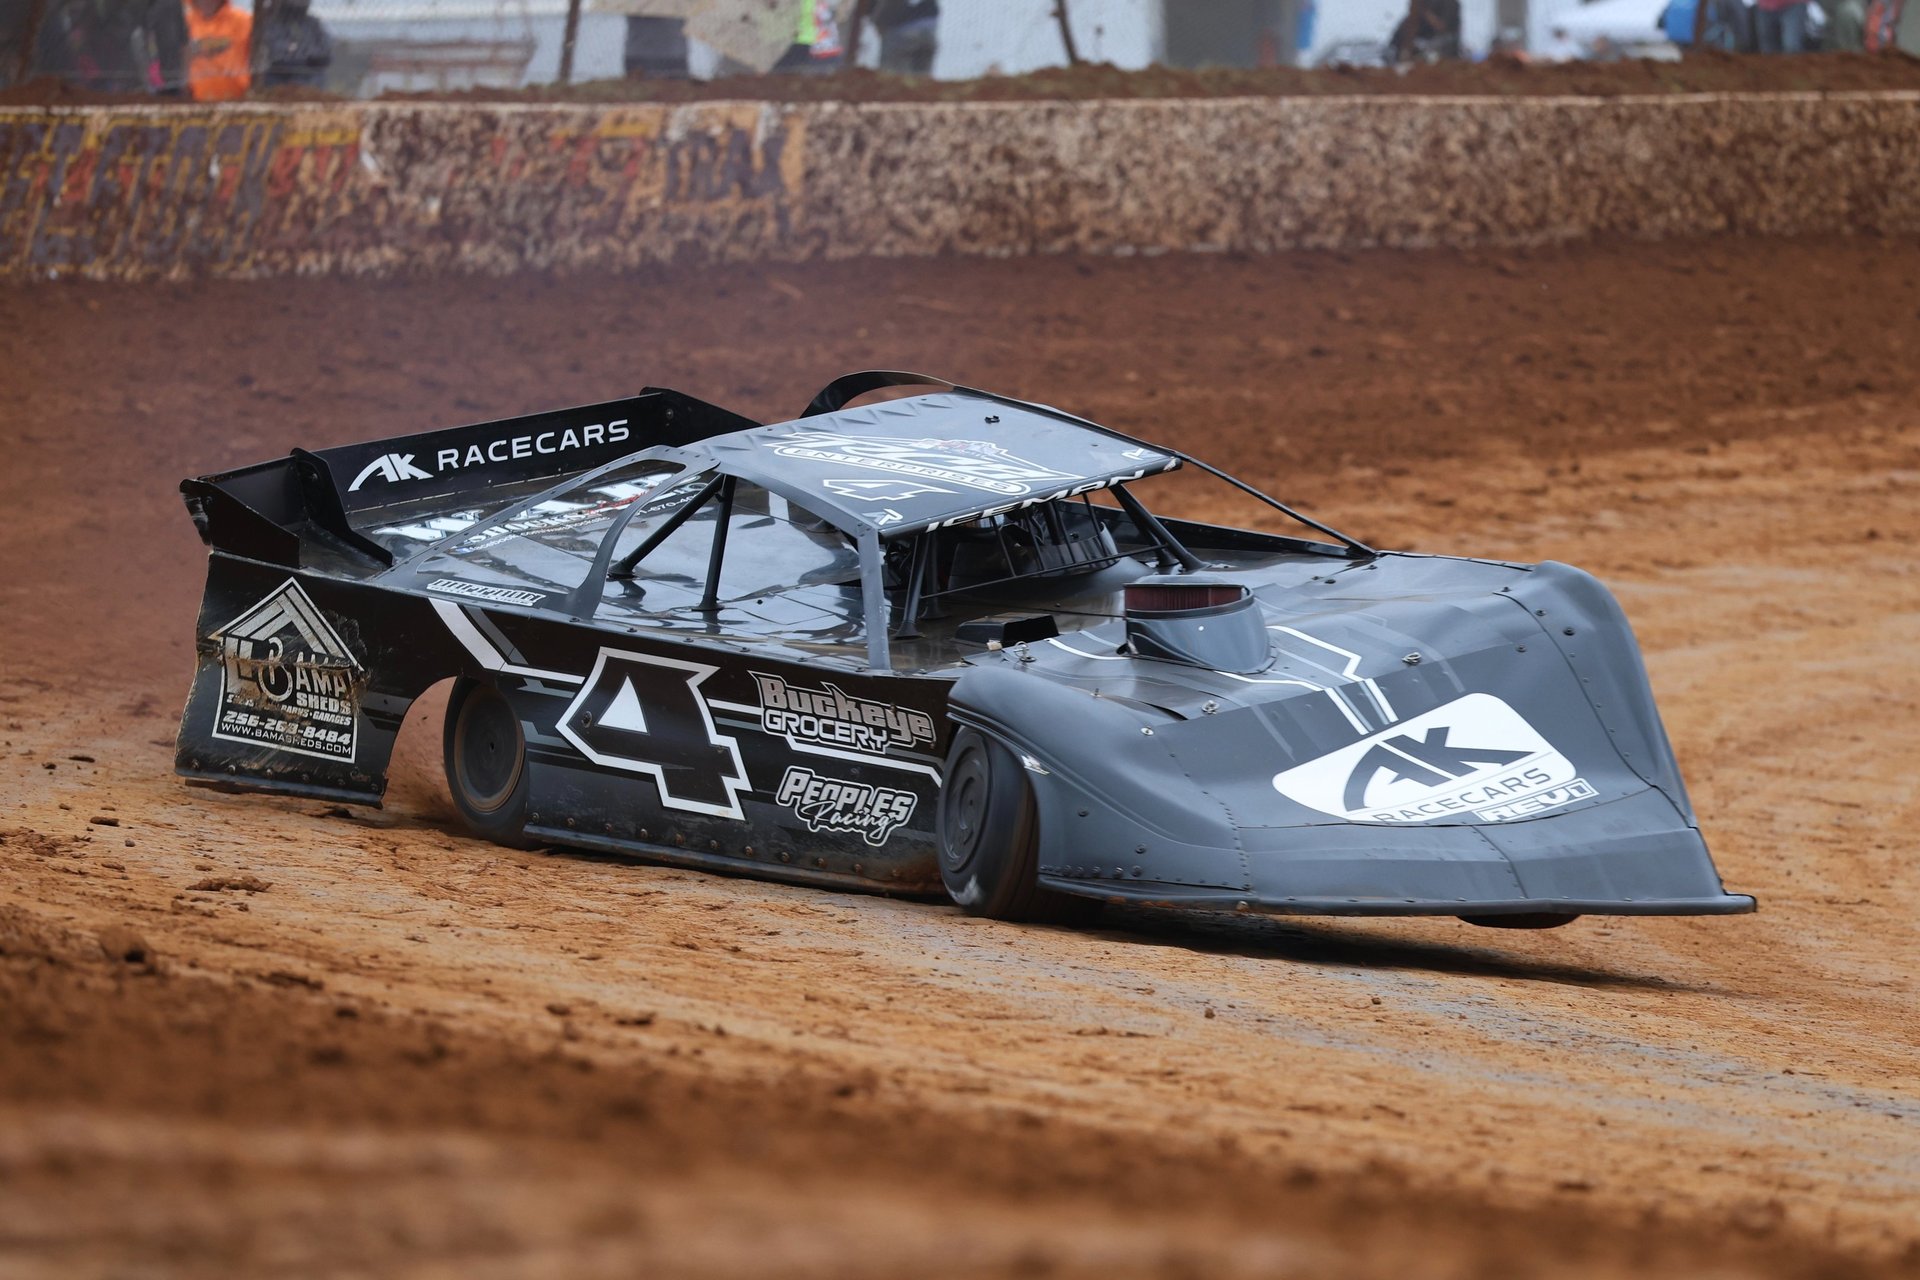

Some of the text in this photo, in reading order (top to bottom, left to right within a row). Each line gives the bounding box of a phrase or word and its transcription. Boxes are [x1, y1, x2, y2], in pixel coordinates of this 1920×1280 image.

[348, 419, 629, 492] AK RACECARS
[794, 447, 1013, 492] ENTERPRISES
[823, 479, 962, 501] 4
[296, 691, 352, 715] SHEDS
[312, 711, 352, 726] GARAGES
[758, 676, 932, 742] Buckeye
[555, 646, 753, 821] 4
[764, 709, 888, 749] GROCERY
[1343, 726, 1537, 812] AK
[780, 771, 914, 821] PEOPLES
[1372, 768, 1552, 823] RACECARS
[800, 800, 894, 840] Racing
